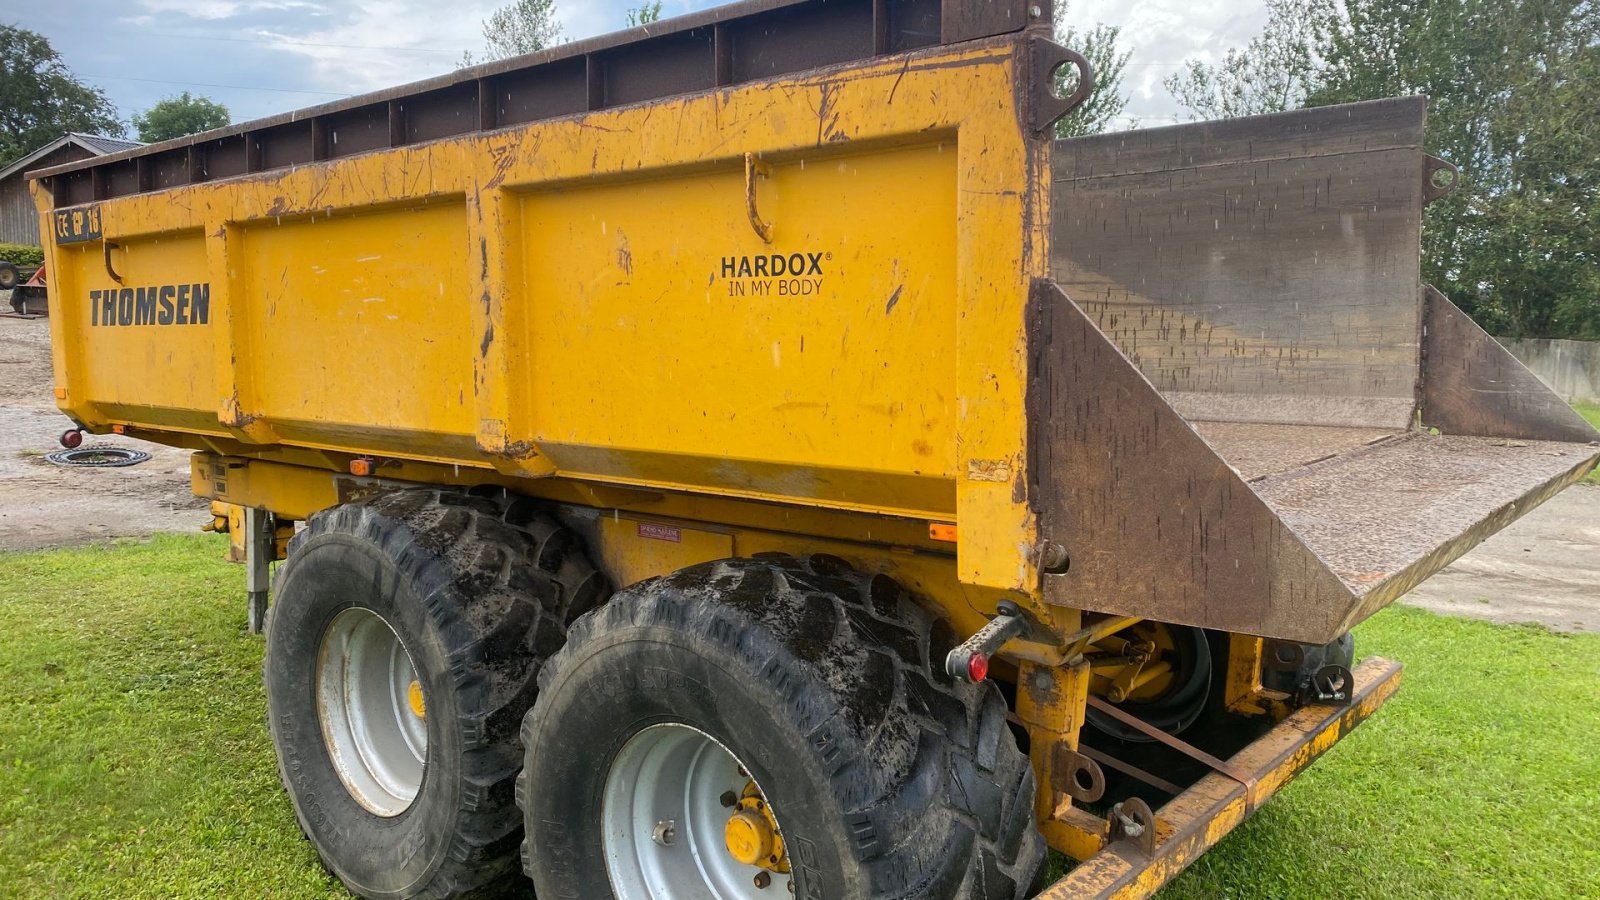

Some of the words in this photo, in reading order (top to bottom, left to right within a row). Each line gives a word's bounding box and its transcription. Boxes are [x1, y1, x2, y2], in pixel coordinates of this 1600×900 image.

[729, 281, 745, 297] IN
[751, 280, 773, 296] MY
[778, 278, 824, 296] BODY
[89, 283, 210, 327] THOMSEN
